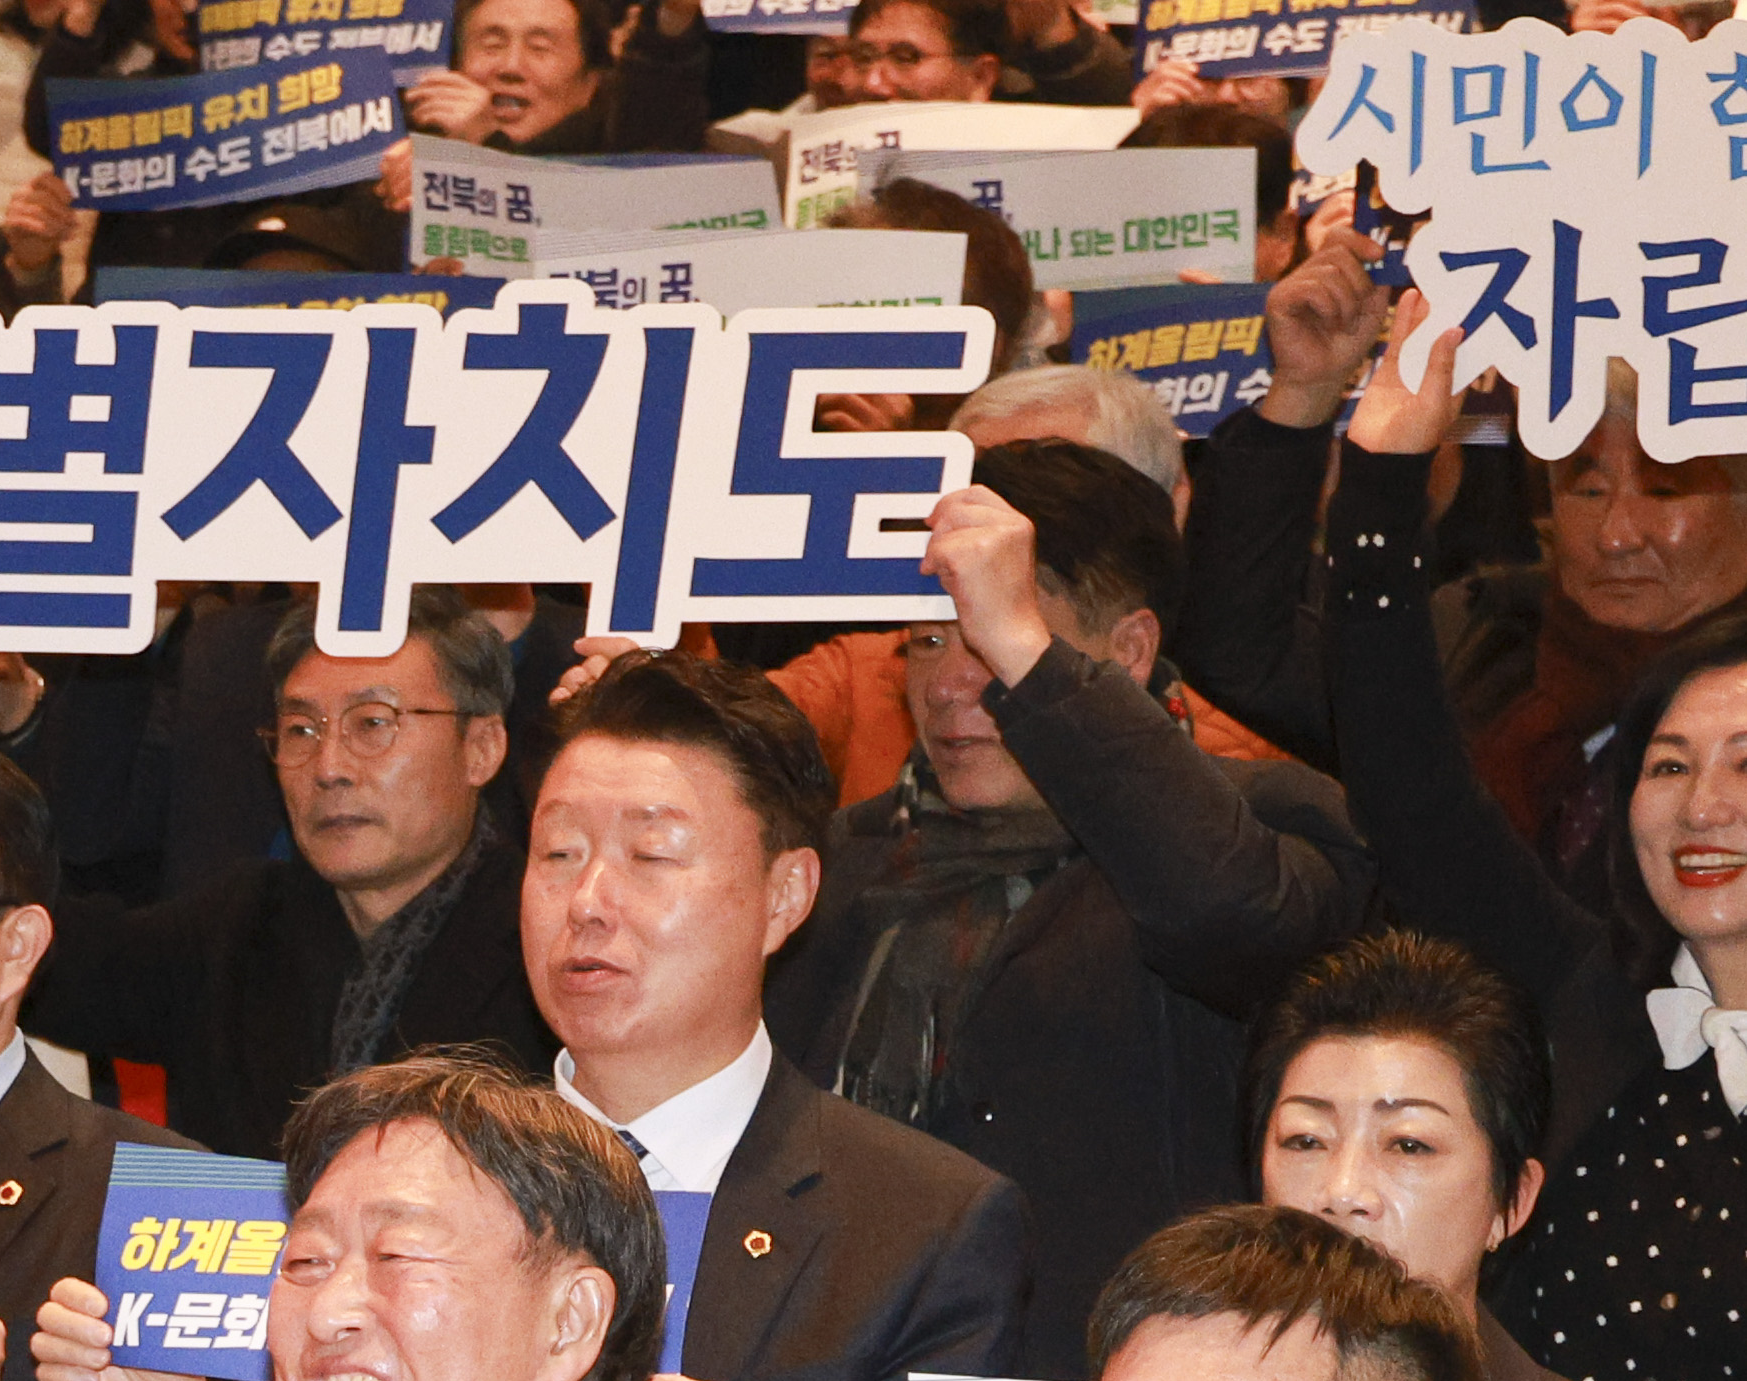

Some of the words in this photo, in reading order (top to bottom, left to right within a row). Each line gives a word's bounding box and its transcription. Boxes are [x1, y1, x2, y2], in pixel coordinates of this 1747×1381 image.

[1263, 17, 1329, 56] 수도
[58, 103, 194, 154] 하계올림픽
[202, 83, 269, 133] 유치
[276, 62, 344, 112] 희망
[1325, 50, 1658, 180] 시민이
[183, 135, 253, 182] 수도
[260, 95, 394, 167] 전북에서
[422, 170, 499, 218] 전북의
[423, 223, 531, 263] 올림픽으로
[1069, 228, 1115, 259] 되는
[1122, 208, 1241, 254] 대한민국
[549, 268, 648, 309] 북의
[1084, 314, 1266, 372] 하계올림픽
[118, 1215, 287, 1276] 하계올
[111, 1290, 270, 1352] K-문화
